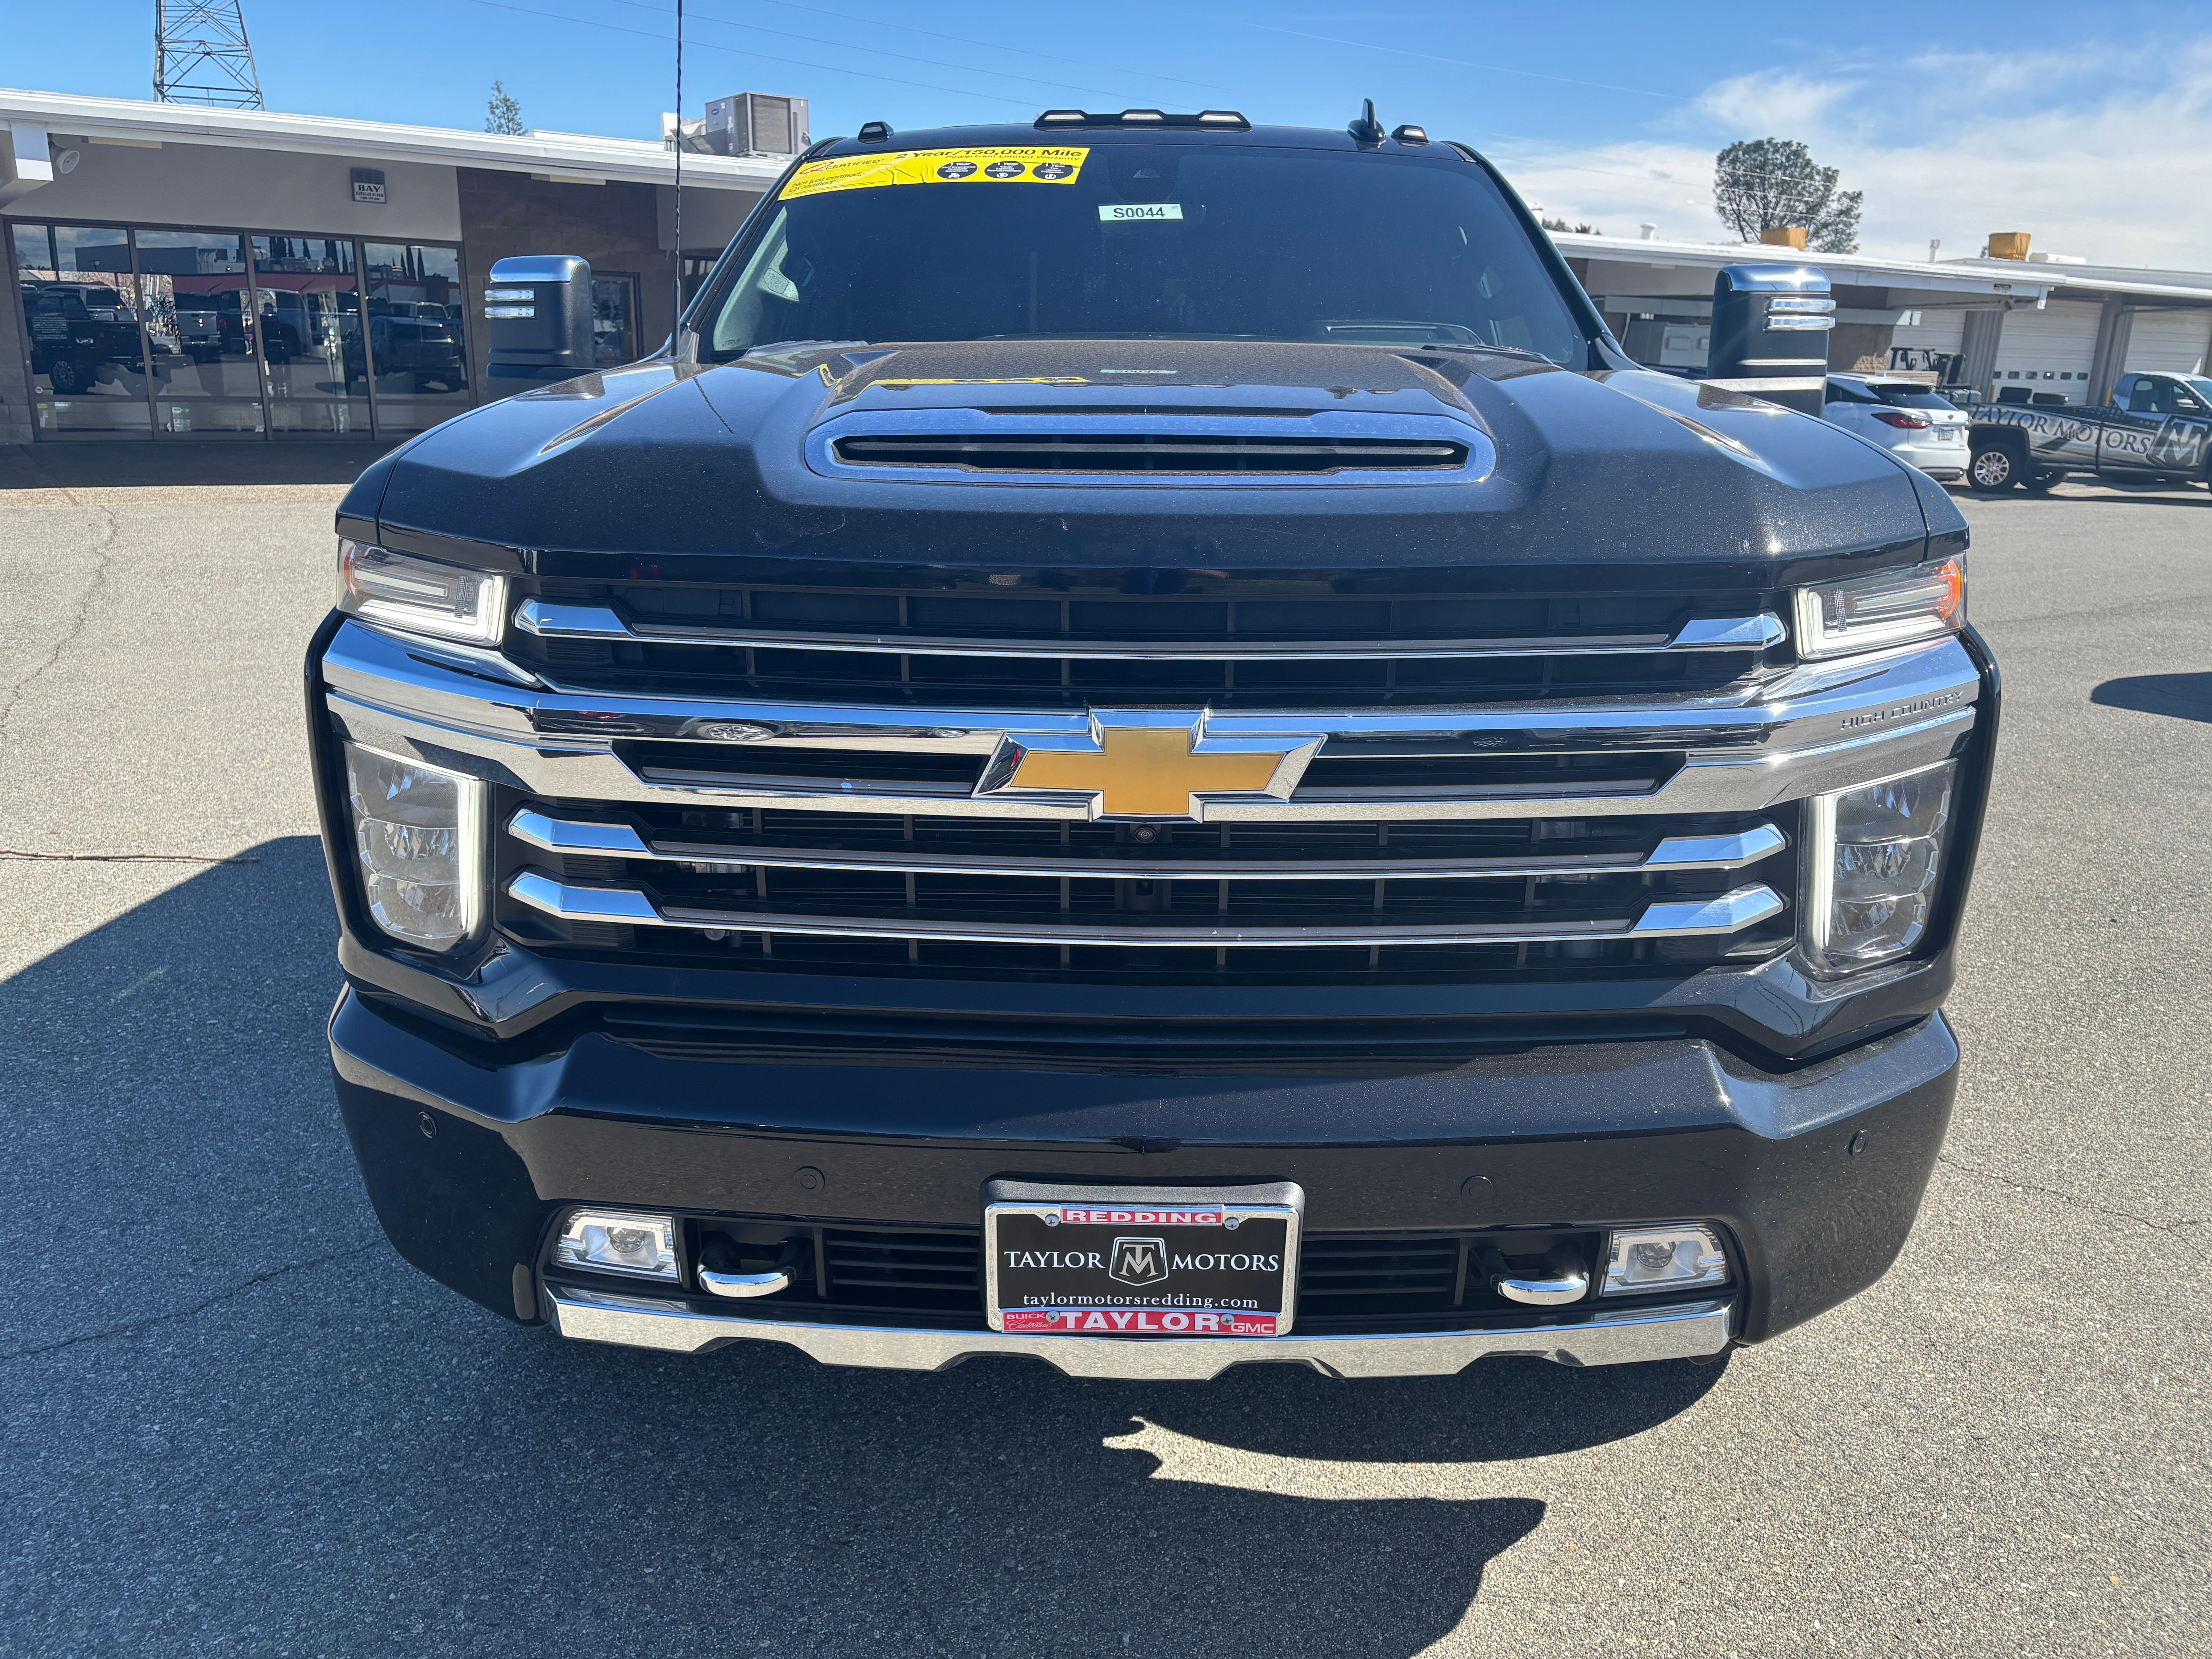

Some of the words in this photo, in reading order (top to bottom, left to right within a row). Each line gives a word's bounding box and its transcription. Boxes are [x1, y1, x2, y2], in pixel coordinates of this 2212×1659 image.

[359, 184, 380, 192] BAY
[1113, 207, 1166, 218] S0044
[1970, 404, 2048, 435] TAYLOR
[2052, 419, 2150, 454] MOTORS
[1841, 711, 1884, 730] HIGH
[1891, 690, 1965, 719] COUNTRY
[1066, 1211, 1217, 1223] REDDING
[1004, 1251, 1106, 1269] TAYLOR
[1171, 1254, 1278, 1271] MOTORS
[1024, 1292, 1259, 1309] taylormotorsredding.com
[1006, 1319, 1051, 1330] Cadillac
[1060, 1312, 1219, 1331] TAYLOR
[1231, 1322, 1274, 1333] GMC
